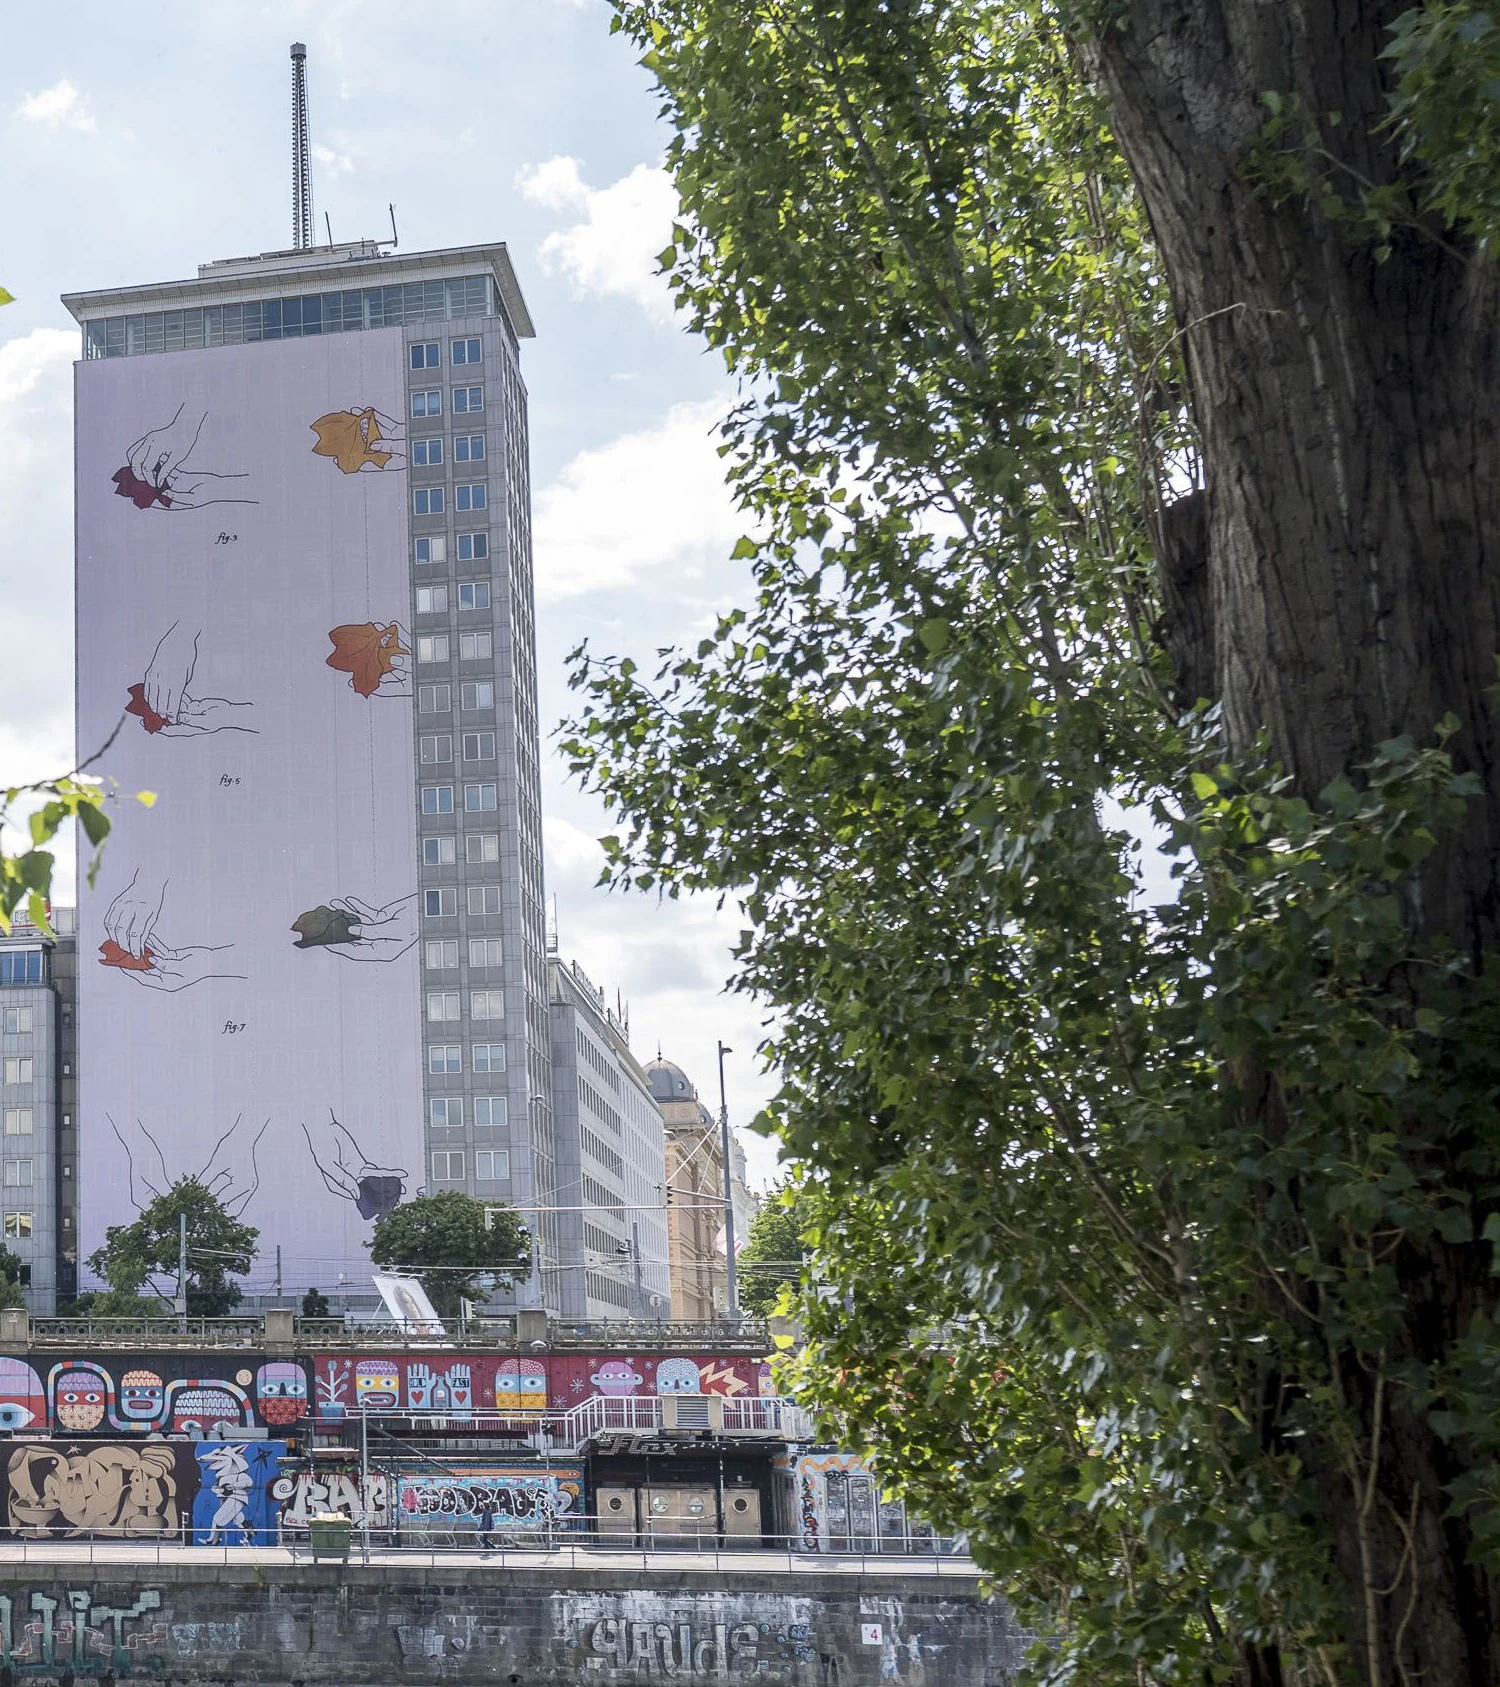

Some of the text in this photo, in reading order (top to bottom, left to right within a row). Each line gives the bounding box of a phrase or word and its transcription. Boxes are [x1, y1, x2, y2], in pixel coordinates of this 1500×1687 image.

[221, 1021, 246, 1035] fig.7
[409, 1378, 426, 1388] HOLD
[452, 1378, 470, 1388] FAST
